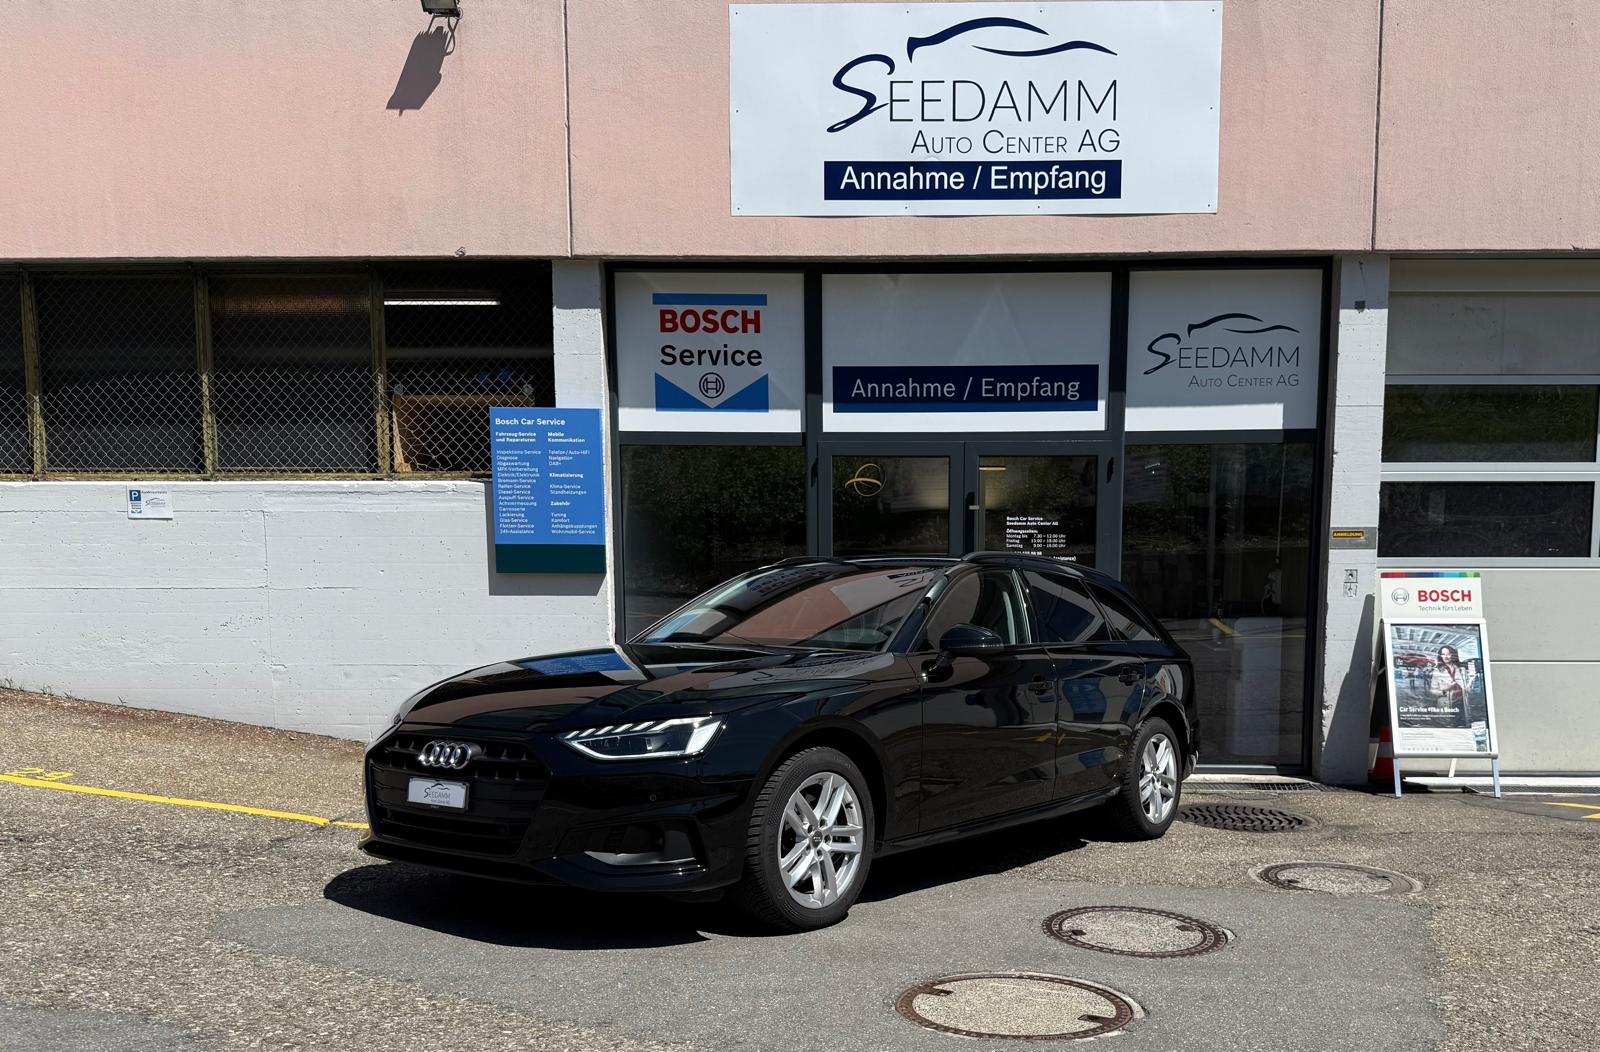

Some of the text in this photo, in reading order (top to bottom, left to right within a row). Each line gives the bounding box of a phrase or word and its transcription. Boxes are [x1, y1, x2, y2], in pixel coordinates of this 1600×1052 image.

[826, 53, 1118, 133] SEEDAMM
[911, 128, 1121, 155] AUTO CENTER AG
[840, 165, 1107, 195] Annahme / Empfang
[659, 308, 761, 334] BOSCH
[660, 344, 763, 367] Service
[1143, 333, 1300, 375] SEEDAMM
[851, 376, 1080, 401] Annahme / Empfang
[1276, 373, 1300, 387] AG
[495, 418, 566, 426] Bosch Car Service
[131, 491, 139, 501] P
[1417, 589, 1472, 602] BOSCH
